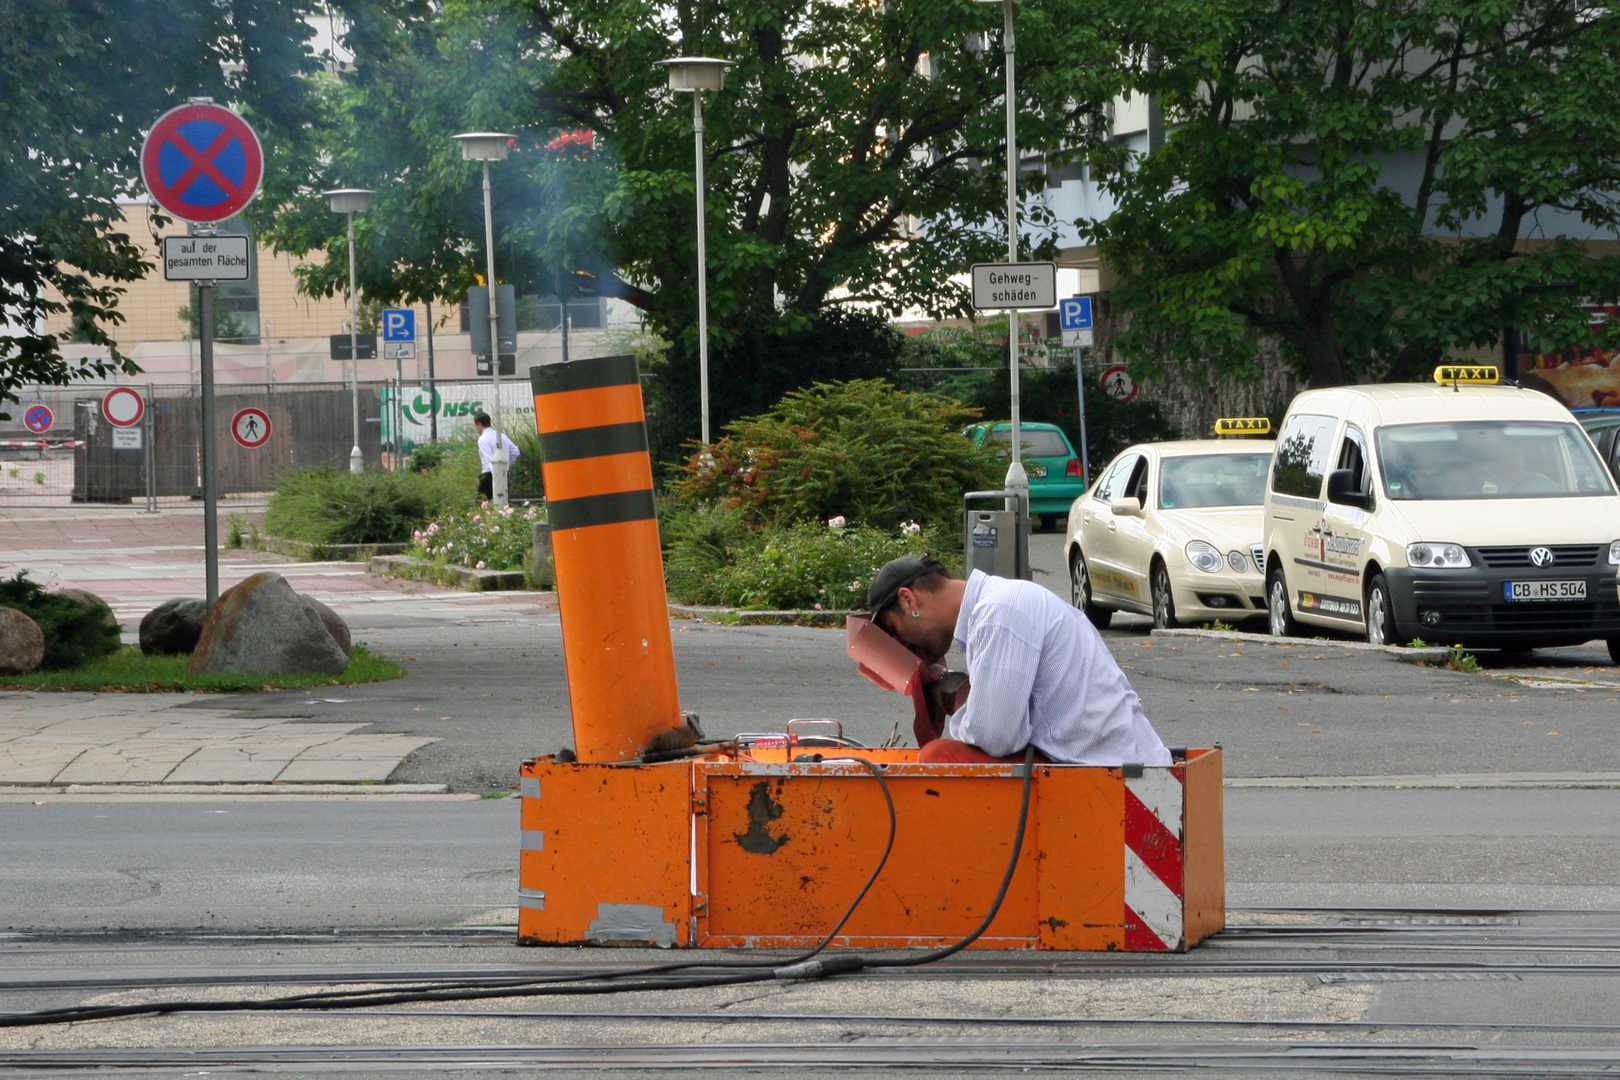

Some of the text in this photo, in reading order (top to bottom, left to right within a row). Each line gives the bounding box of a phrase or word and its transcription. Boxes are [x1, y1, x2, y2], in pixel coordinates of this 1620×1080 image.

[181, 240, 217, 253] auf der
[168, 255, 246, 269] gesamten Fläche
[989, 272, 1039, 286] Gehweg-
[992, 289, 1037, 301] schäden
[1065, 302, 1081, 326] P
[388, 313, 405, 337] P
[1448, 368, 1489, 379] TAXI
[443, 401, 483, 417] NSG
[1227, 420, 1262, 429] TAXI
[1513, 582, 1585, 597] CB HS 504
